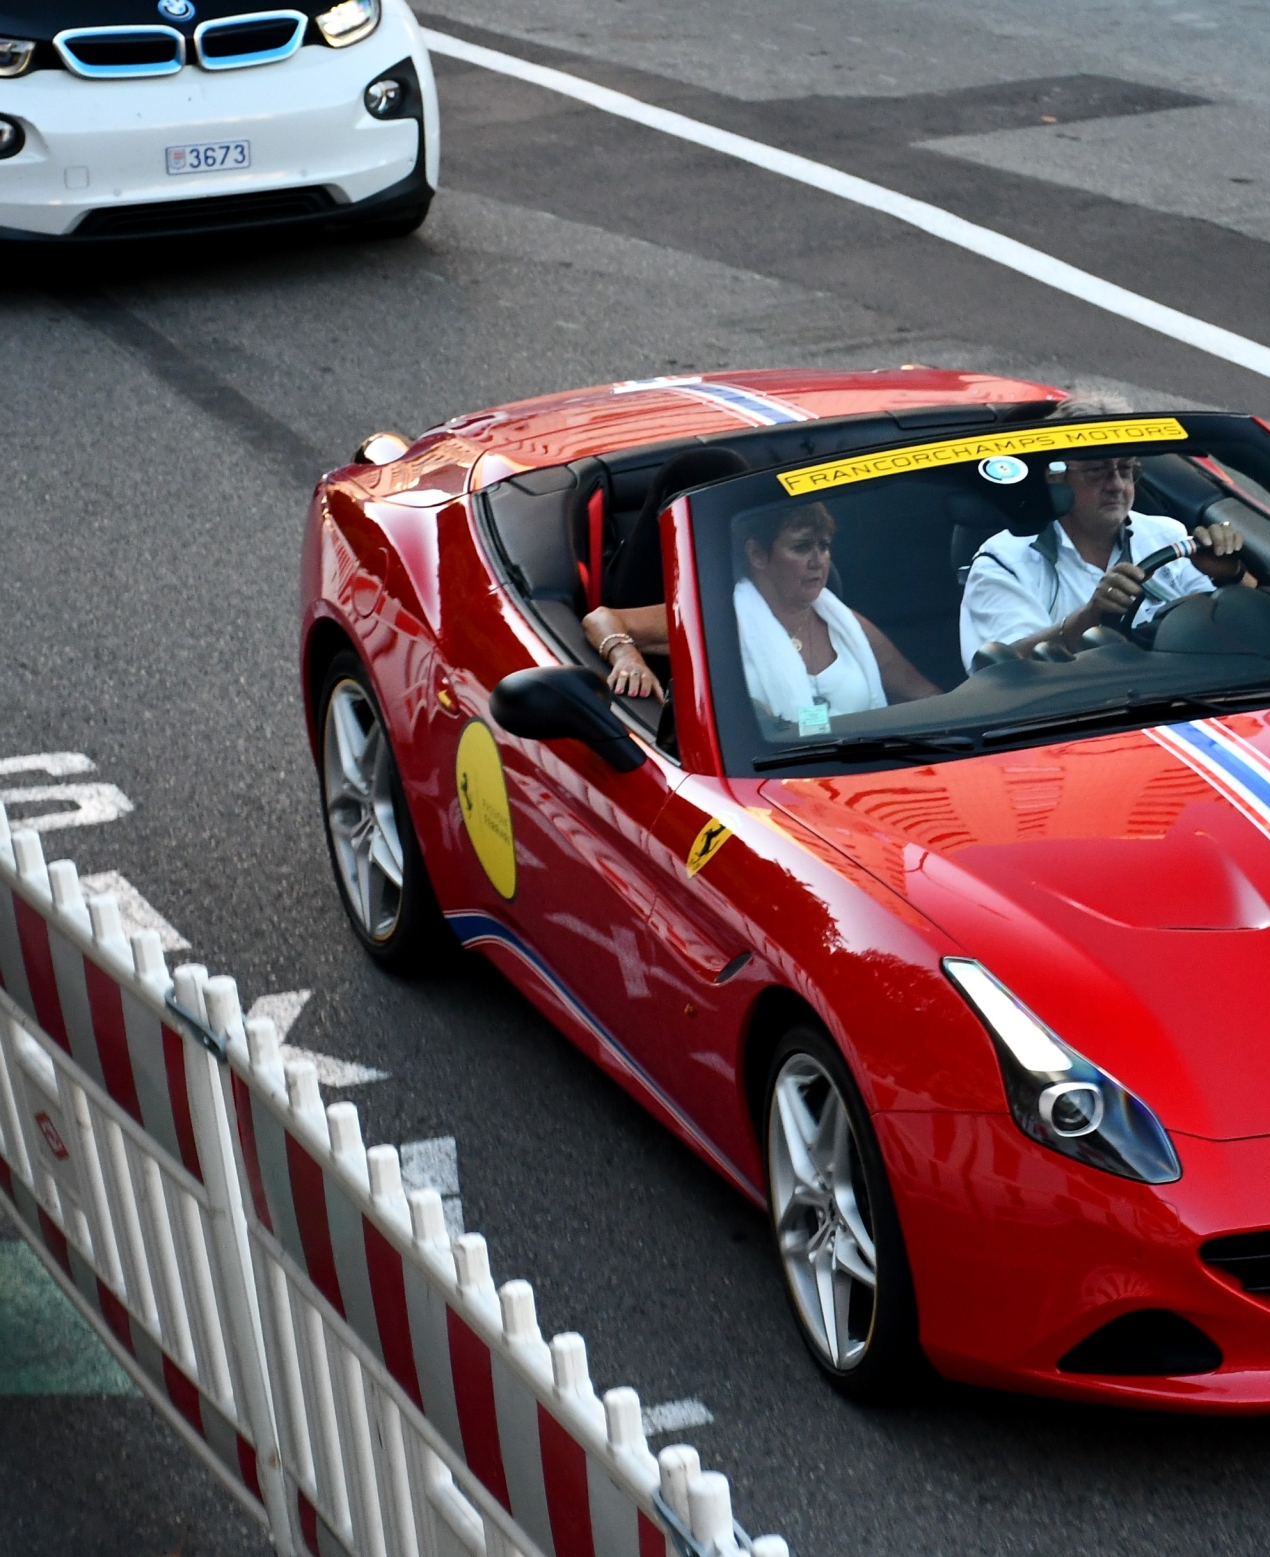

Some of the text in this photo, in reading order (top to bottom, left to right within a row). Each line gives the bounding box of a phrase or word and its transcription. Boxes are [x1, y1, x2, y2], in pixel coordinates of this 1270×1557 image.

[189, 144, 246, 168] 3673
[785, 434, 1055, 490] FRANCORCHAMPS
[1066, 425, 1182, 443] MOTORS
